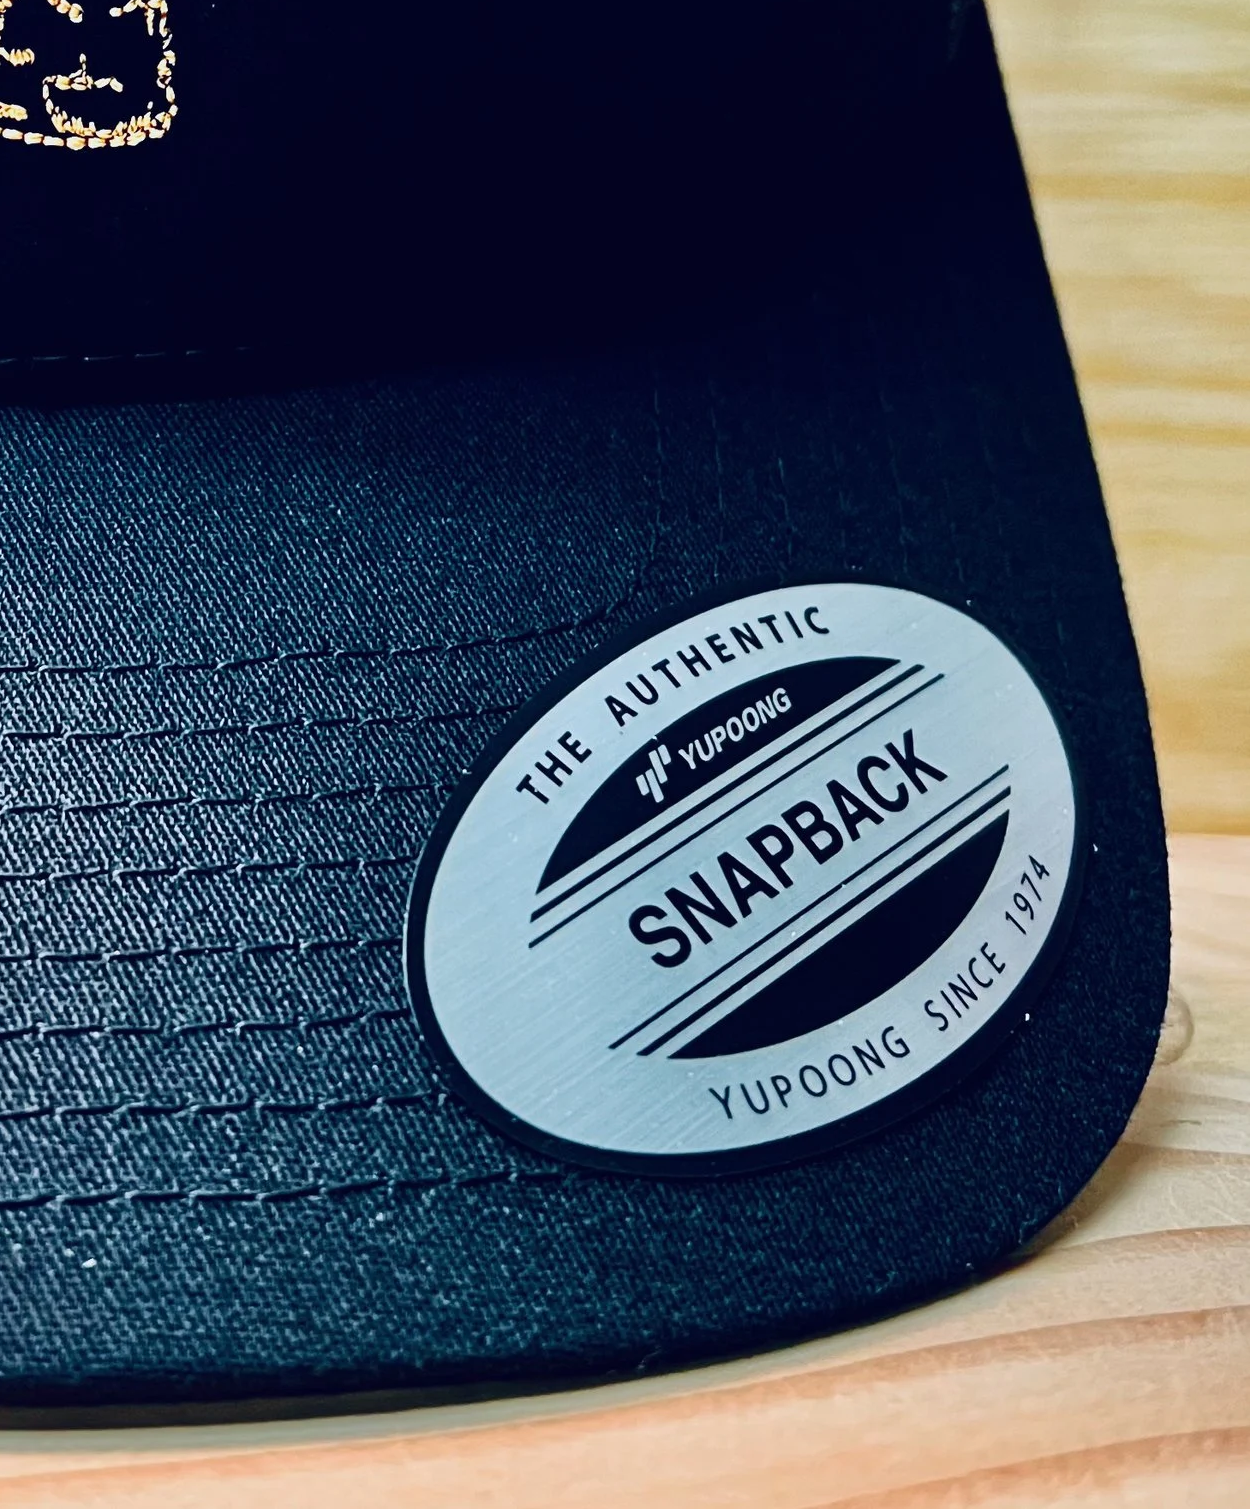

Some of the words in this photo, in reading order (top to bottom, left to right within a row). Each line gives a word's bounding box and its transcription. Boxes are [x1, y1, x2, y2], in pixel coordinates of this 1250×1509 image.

[516, 730, 592, 805] THE
[604, 605, 830, 727] AUTHENTIC
[677, 687, 792, 770] YUPOONG
[628, 729, 948, 968] SNAPBACK
[708, 1026, 911, 1120] YUPOONG
[923, 942, 1008, 1033] SINCE
[1004, 855, 1051, 936] 1974
